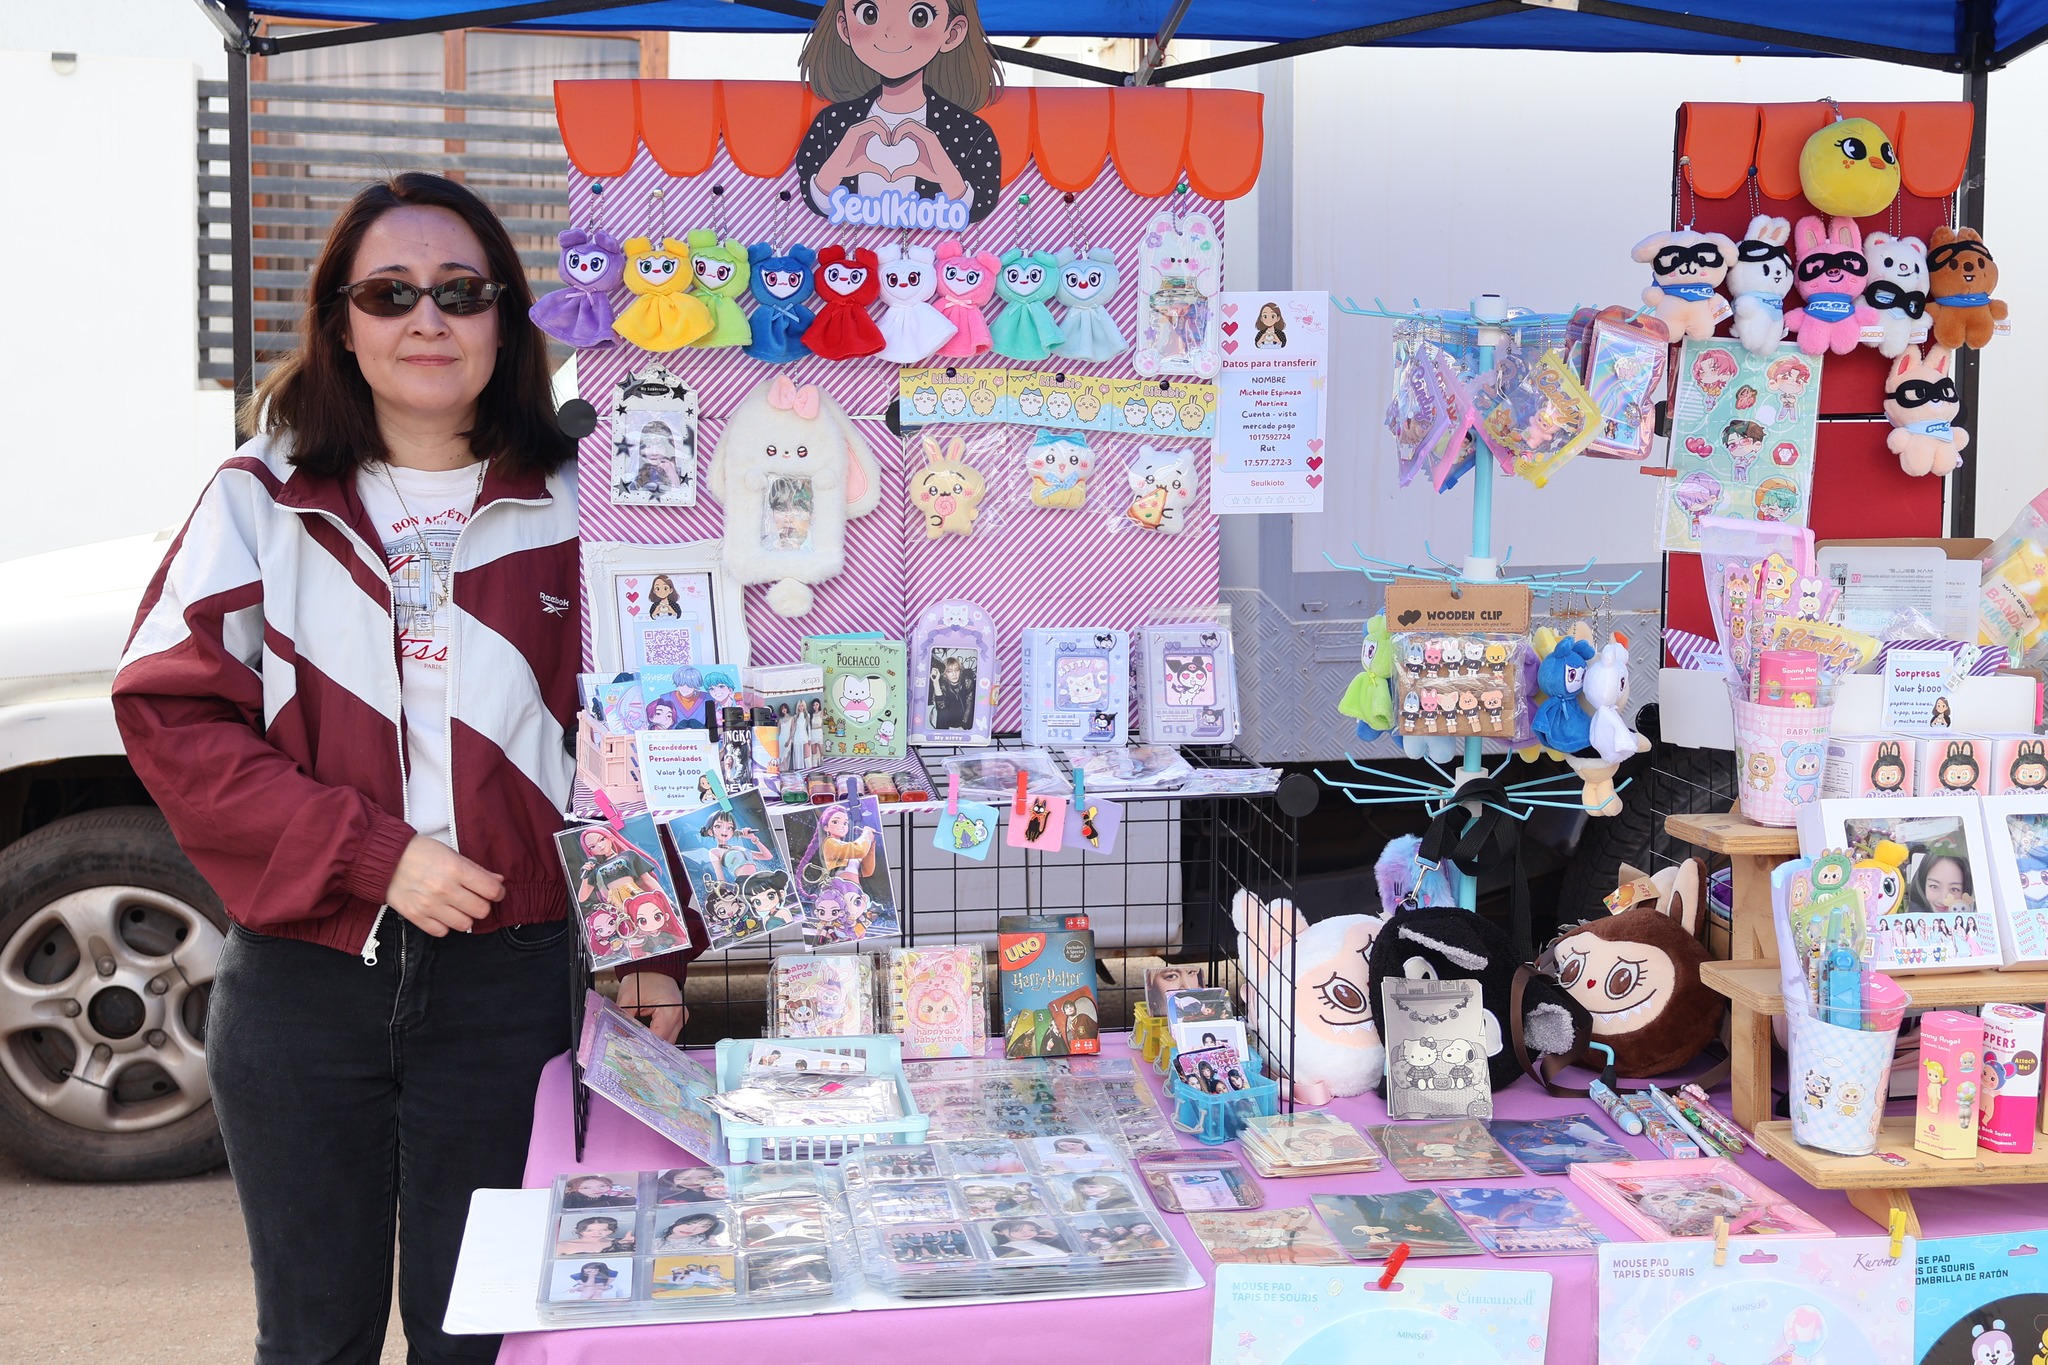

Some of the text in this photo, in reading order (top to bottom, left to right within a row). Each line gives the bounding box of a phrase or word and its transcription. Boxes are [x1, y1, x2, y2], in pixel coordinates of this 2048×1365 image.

[829, 186, 968, 231] Seulkioto
[1222, 359, 1317, 369] Datos para transferir
[1252, 376, 1286, 384] NOMBRE
[1239, 388, 1302, 398] Michelle Espinoza
[1242, 410, 1270, 418] Cuenta
[1244, 458, 1292, 467] 17.577.272-3
[392, 516, 420, 534] BON
[540, 592, 570, 607] Reebok
[1426, 610, 1502, 620] WOODEN CLIP
[1784, 628, 1856, 666] Candy
[837, 656, 880, 666] POCHACCO
[1895, 668, 1940, 680] Sorpresas
[1894, 683, 1942, 694] Valor $1.000
[1786, 728, 1809, 736] BABY
[2013, 910, 2028, 920] twice
[2015, 916, 2032, 928] twice
[2017, 926, 2034, 937] twice
[2019, 934, 2036, 946] twice
[1004, 936, 1041, 962] UNO
[2021, 944, 2038, 956] twice
[787, 971, 812, 982] three
[1012, 968, 1081, 994] Harry Potter
[1052, 1004, 1058, 1012] 1
[1022, 1012, 1030, 1020] 7
[1038, 1014, 1044, 1022] 3
[1940, 1036, 1960, 1046] Angel
[1613, 1258, 1670, 1268] MOUSE PAD
[1853, 1254, 1900, 1272] Kuromi
[1932, 1254, 1950, 1263] PAD
[1613, 1268, 1695, 1278] TAPIS DE SOURIS
[1926, 1266, 1938, 1275] DE
[1941, 1262, 1975, 1273] SOURIS
[1964, 1272, 1976, 1281] DE
[1980, 1269, 2008, 1280] RATÓN
[1232, 1282, 1292, 1291] MOUSE PAD
[1232, 1293, 1319, 1302] TAPIS DE SOURIS
[1456, 1288, 1536, 1306] Cinnamoroll
[1732, 1302, 1762, 1312] MINISO
